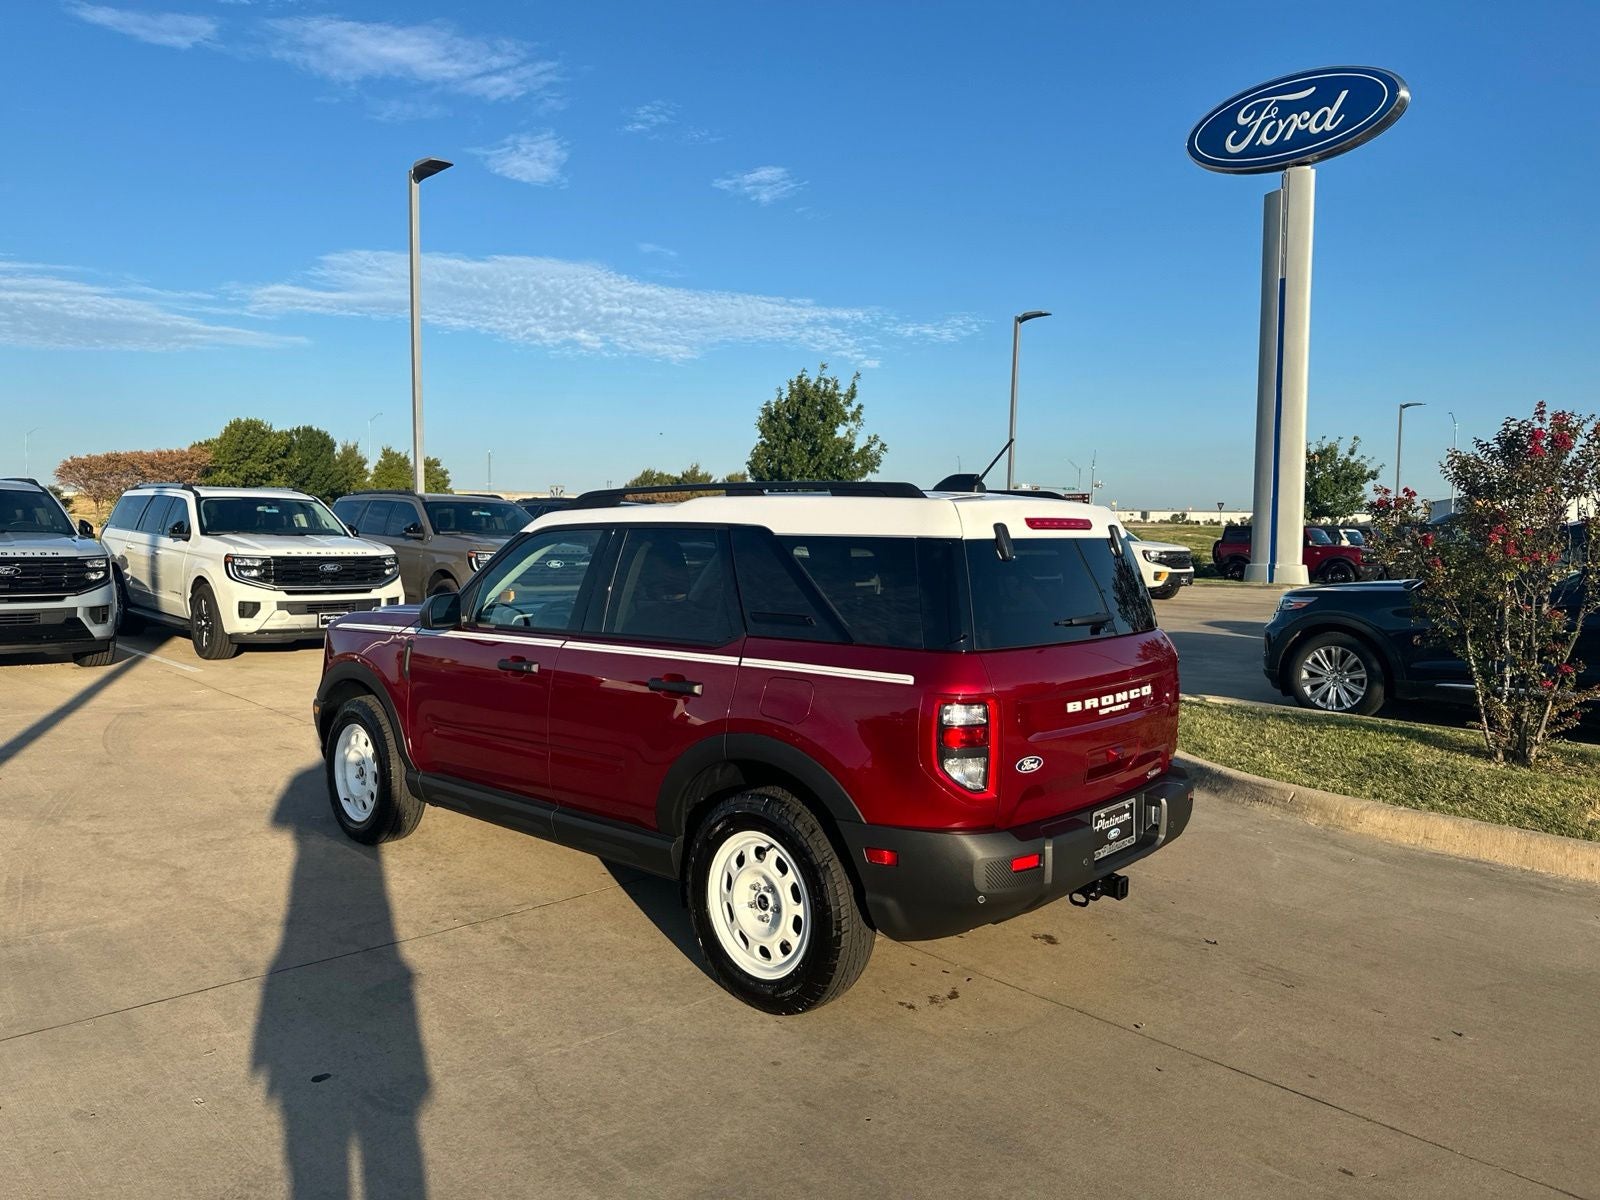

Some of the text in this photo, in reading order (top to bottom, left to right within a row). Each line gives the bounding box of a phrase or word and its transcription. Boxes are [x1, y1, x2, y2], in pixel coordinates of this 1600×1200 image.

[1225, 86, 1349, 154] Ford
[1066, 684, 1152, 713] BRONCO
[1098, 702, 1131, 715] SPORT
[1020, 758, 1040, 771] Ford
[1094, 812, 1132, 832] Platinum
